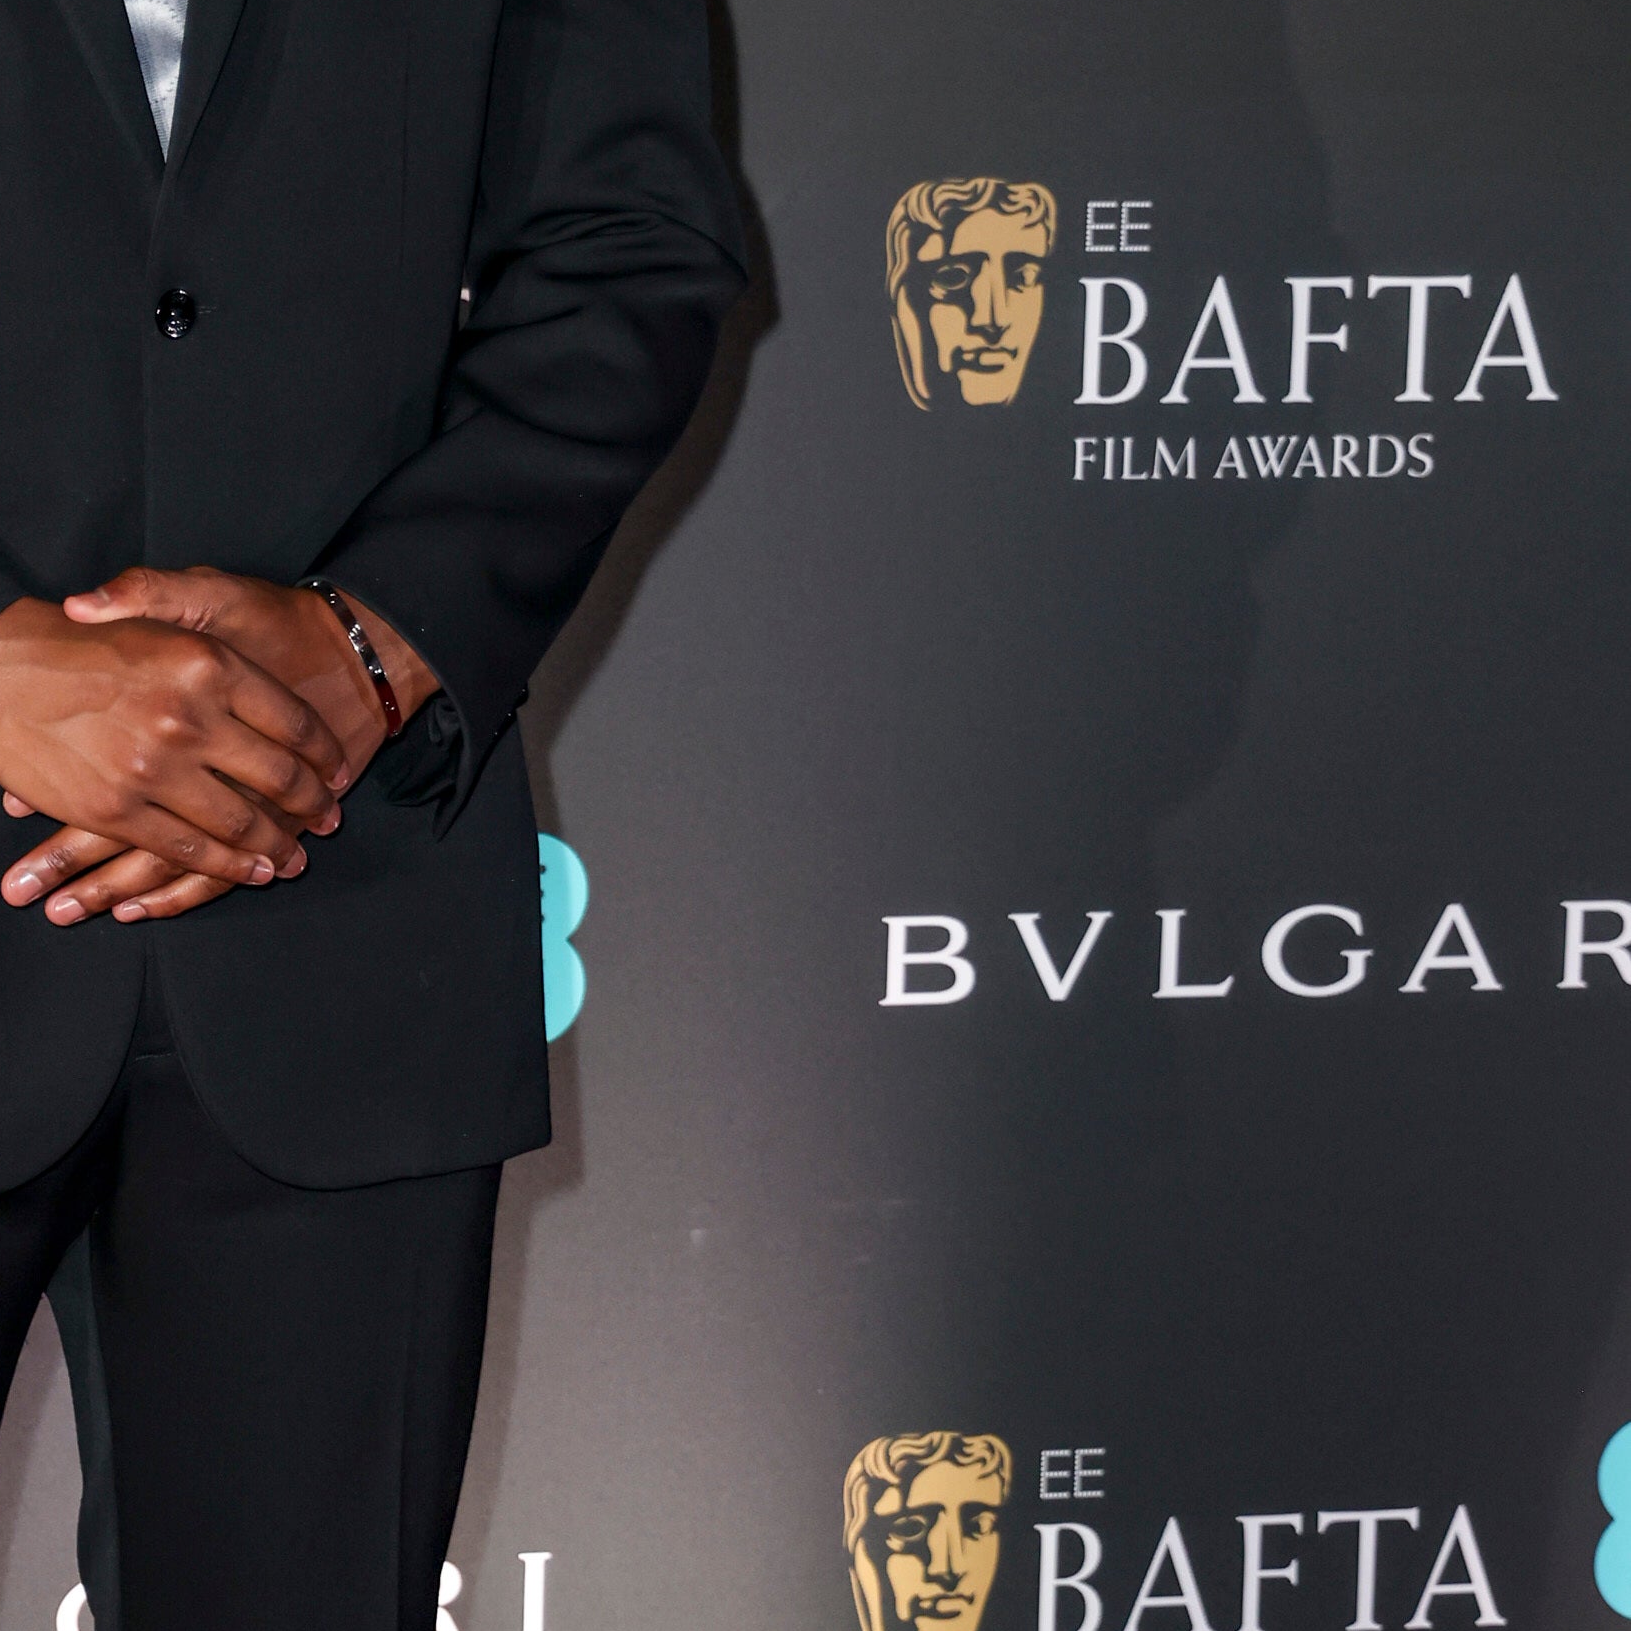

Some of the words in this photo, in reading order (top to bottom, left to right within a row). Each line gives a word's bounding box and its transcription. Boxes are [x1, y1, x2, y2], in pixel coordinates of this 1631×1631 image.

[1086, 202, 1151, 251] EE
[1074, 275, 1558, 404] BAFTA
[1074, 437, 1195, 480] FILM
[1214, 435, 1433, 478] AWARDS
[1040, 1449, 1104, 1499] EE
